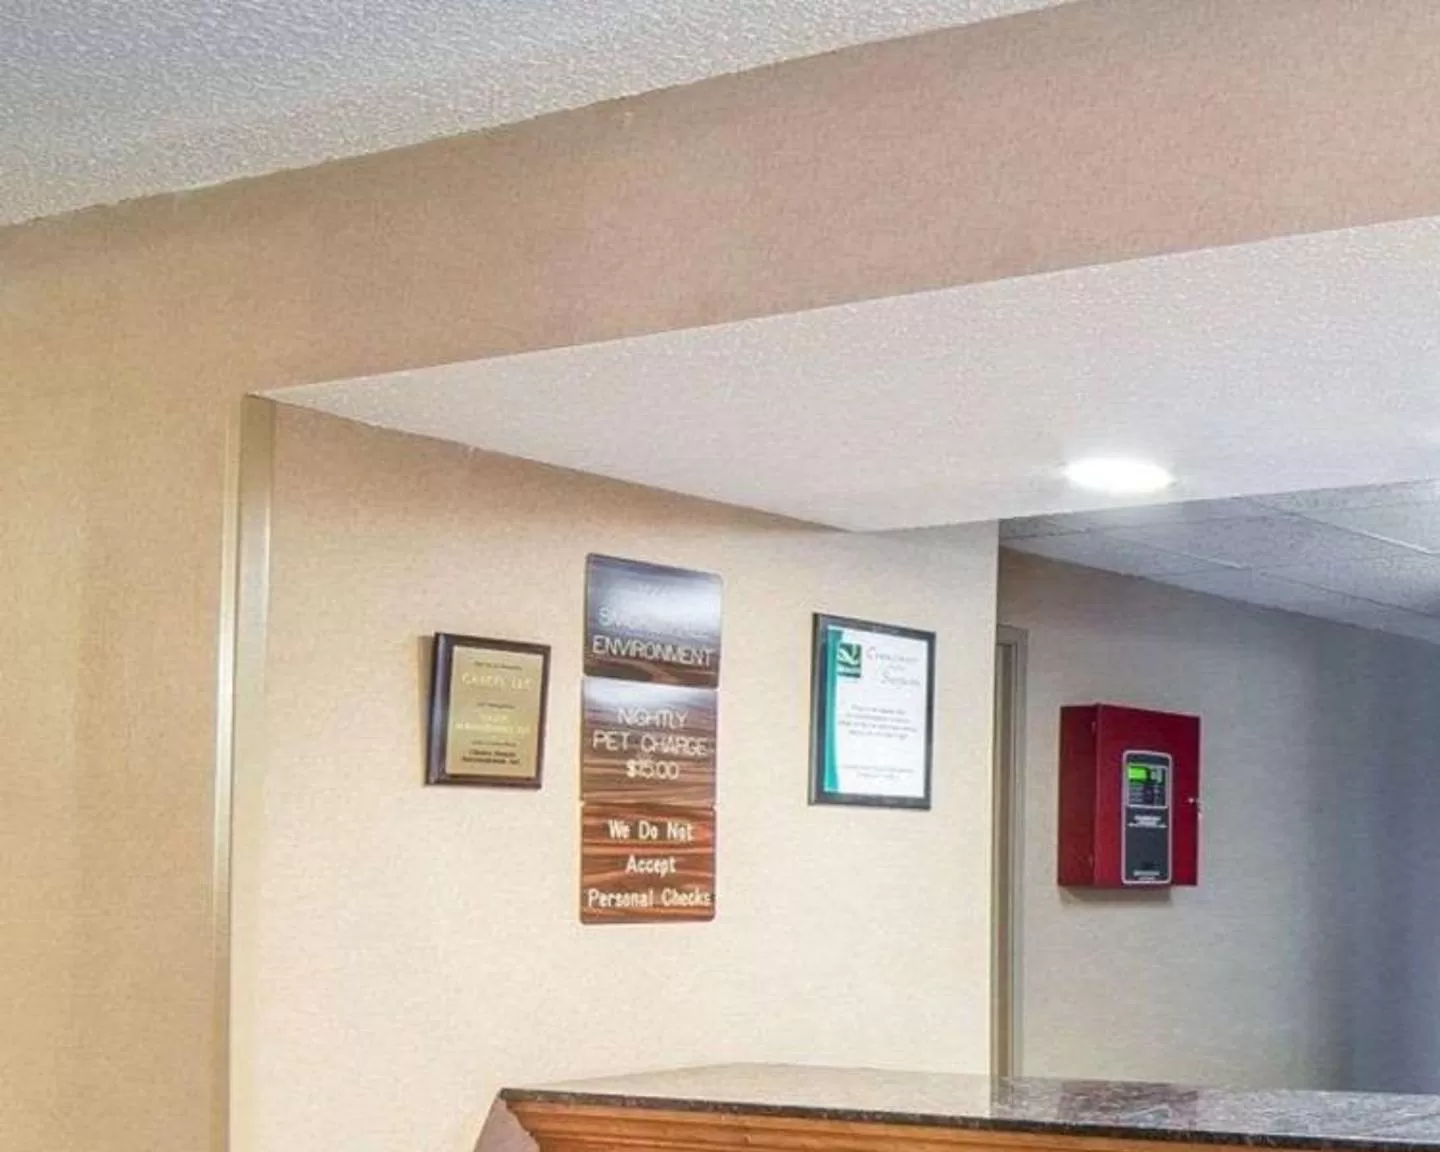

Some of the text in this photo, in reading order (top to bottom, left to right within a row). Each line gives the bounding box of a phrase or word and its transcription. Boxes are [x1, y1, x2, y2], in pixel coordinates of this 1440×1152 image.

[593, 635, 716, 667] ENVIRONMENT
[618, 706, 688, 729] NIGHTLY
[593, 729, 709, 757] PET CHARGE
[608, 819, 693, 842] We Do Not
[625, 854, 676, 877] Accept
[588, 887, 711, 908] Personal Checks
